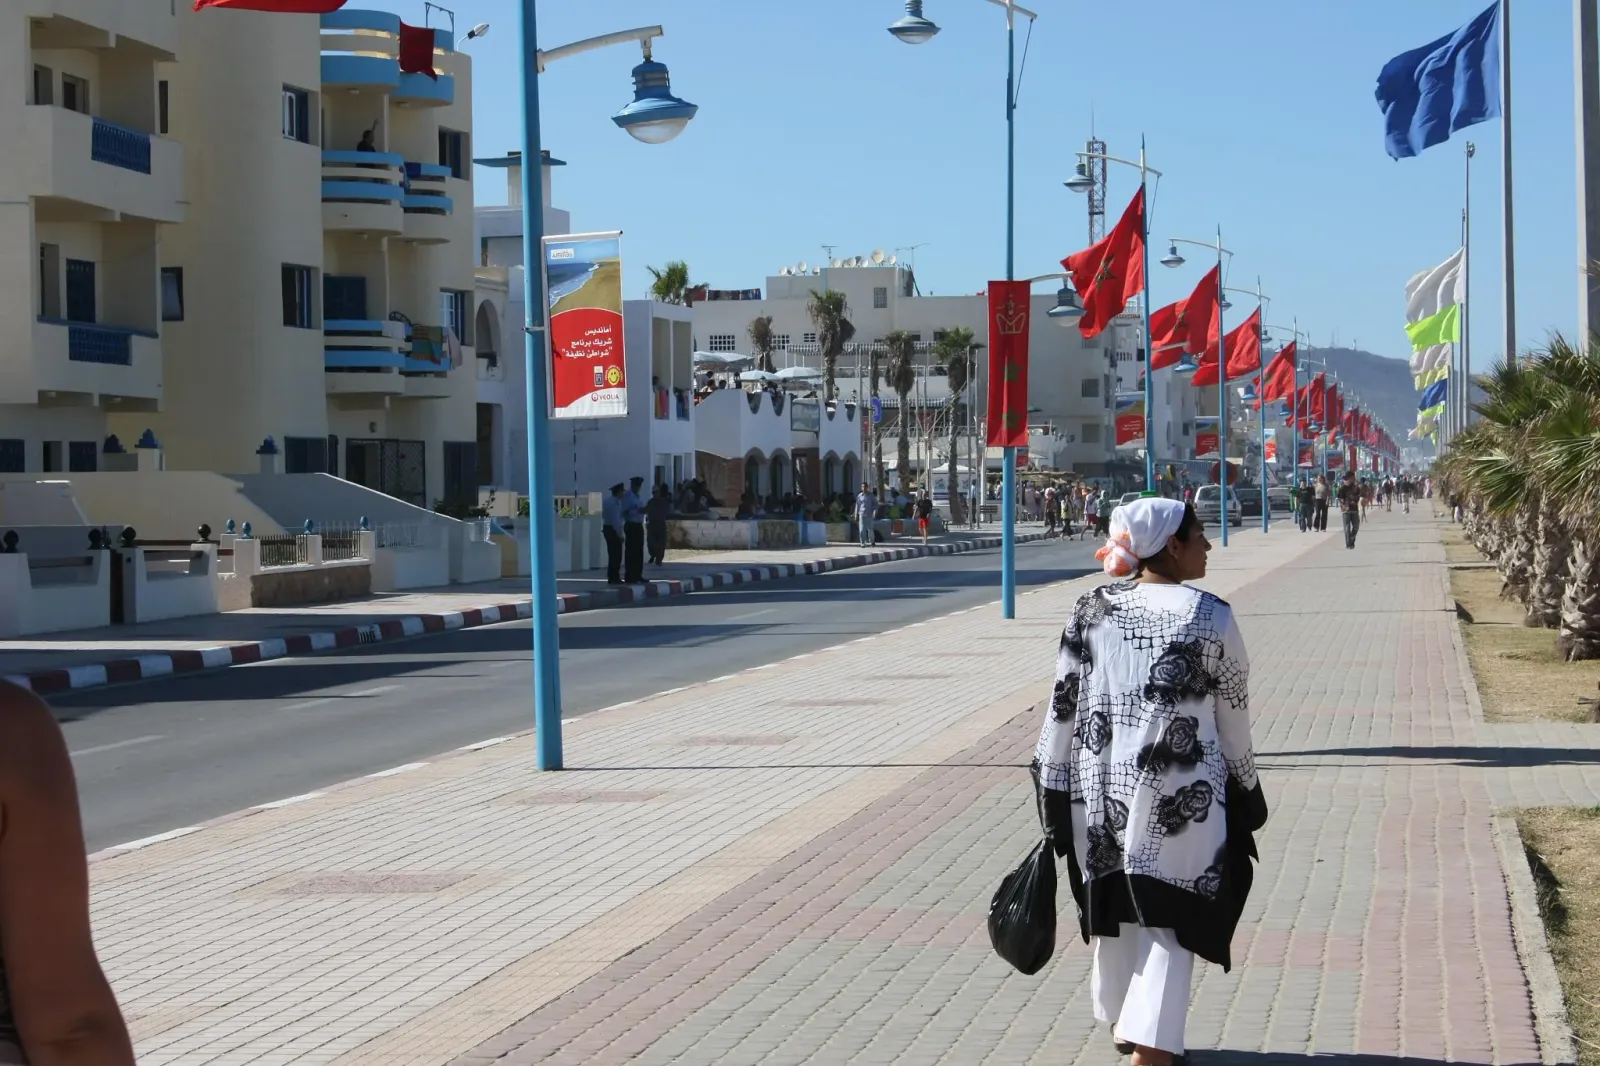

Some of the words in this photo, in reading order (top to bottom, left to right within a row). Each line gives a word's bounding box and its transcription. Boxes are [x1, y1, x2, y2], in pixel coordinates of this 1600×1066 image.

[585, 325, 611, 335] أمانديس
[571, 339, 592, 348] برنامج
[593, 338, 612, 346] شريك
